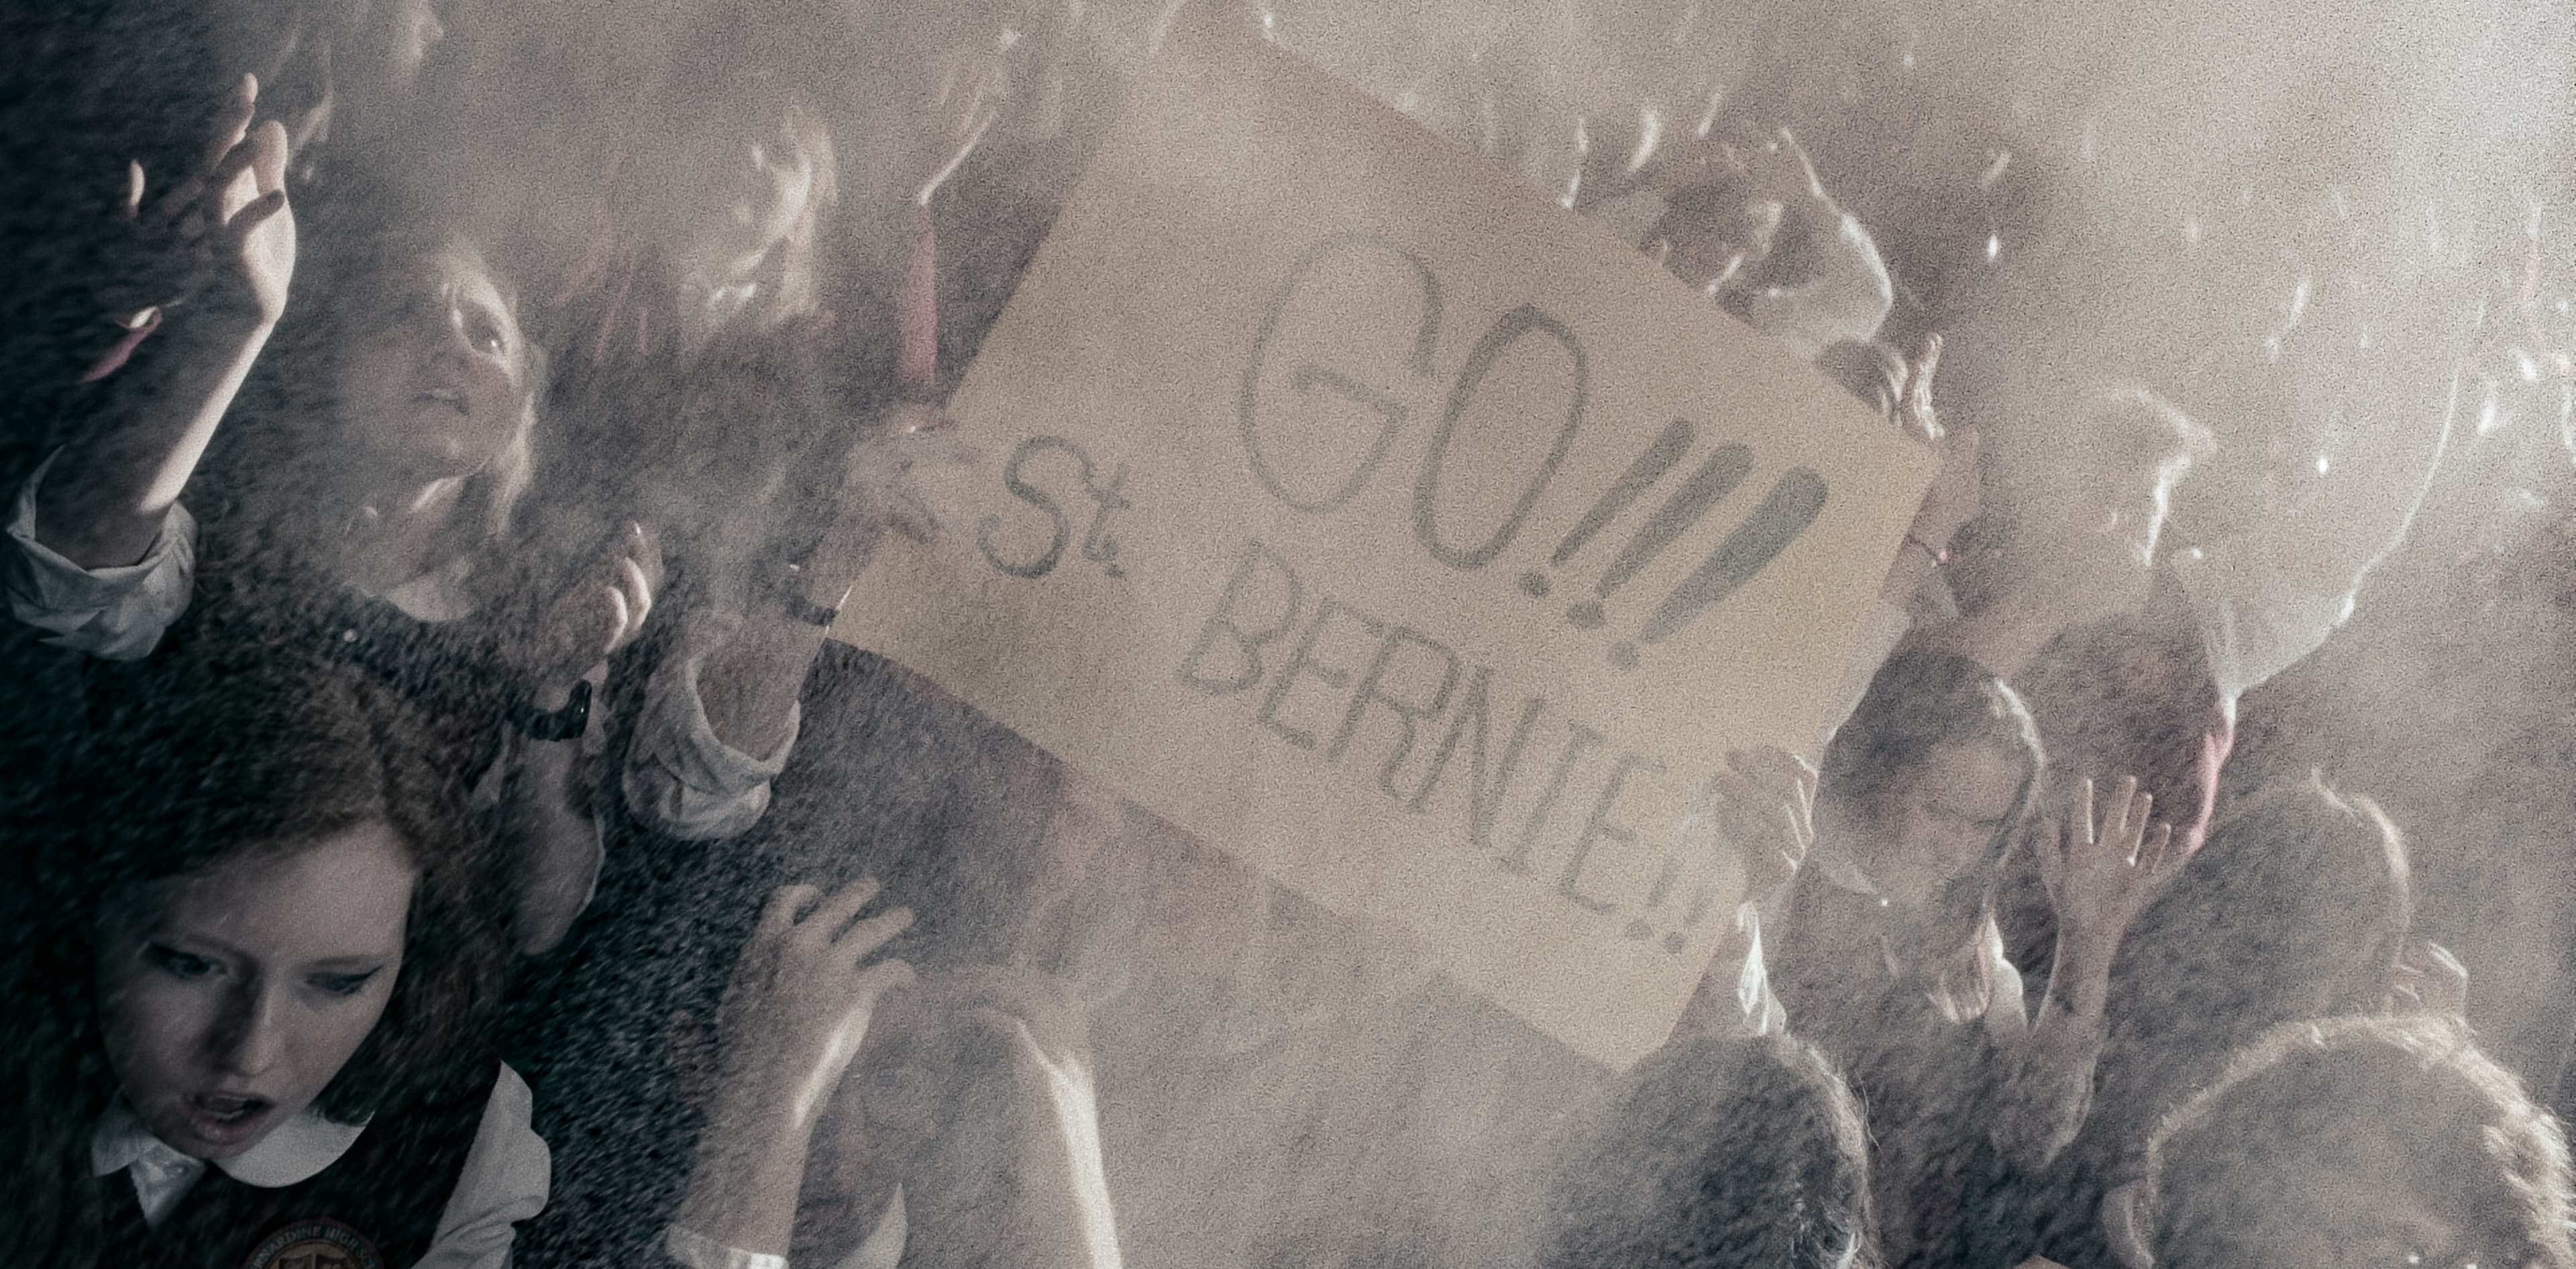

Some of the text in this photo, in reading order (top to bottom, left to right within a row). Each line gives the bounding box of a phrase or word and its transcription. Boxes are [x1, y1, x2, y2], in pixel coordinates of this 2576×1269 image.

[1240, 235, 1829, 669] GO!!!
[977, 435, 1734, 954] St. BERNIE!!
[325, 1227, 360, 1250] HIGH
